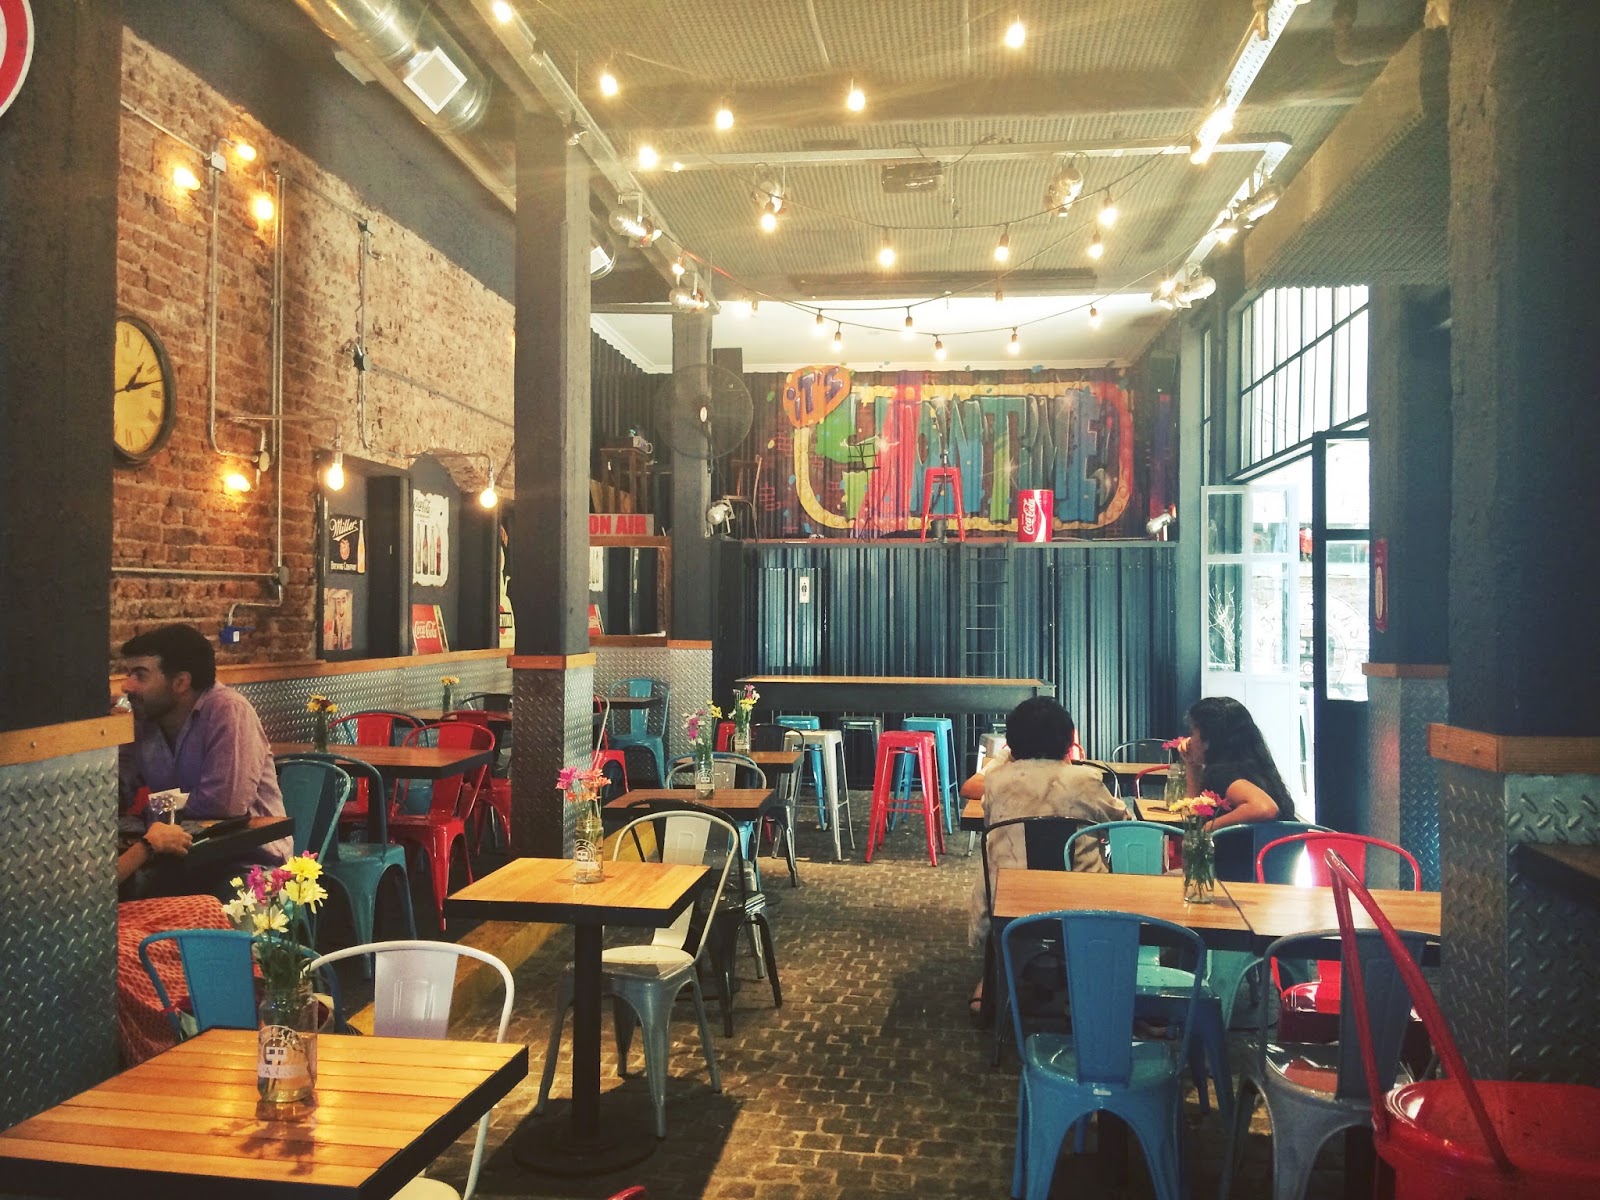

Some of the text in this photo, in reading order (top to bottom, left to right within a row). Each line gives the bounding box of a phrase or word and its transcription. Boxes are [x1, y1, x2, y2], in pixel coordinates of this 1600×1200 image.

[330, 518, 359, 539] Miller
[589, 515, 646, 535] ON AIR
